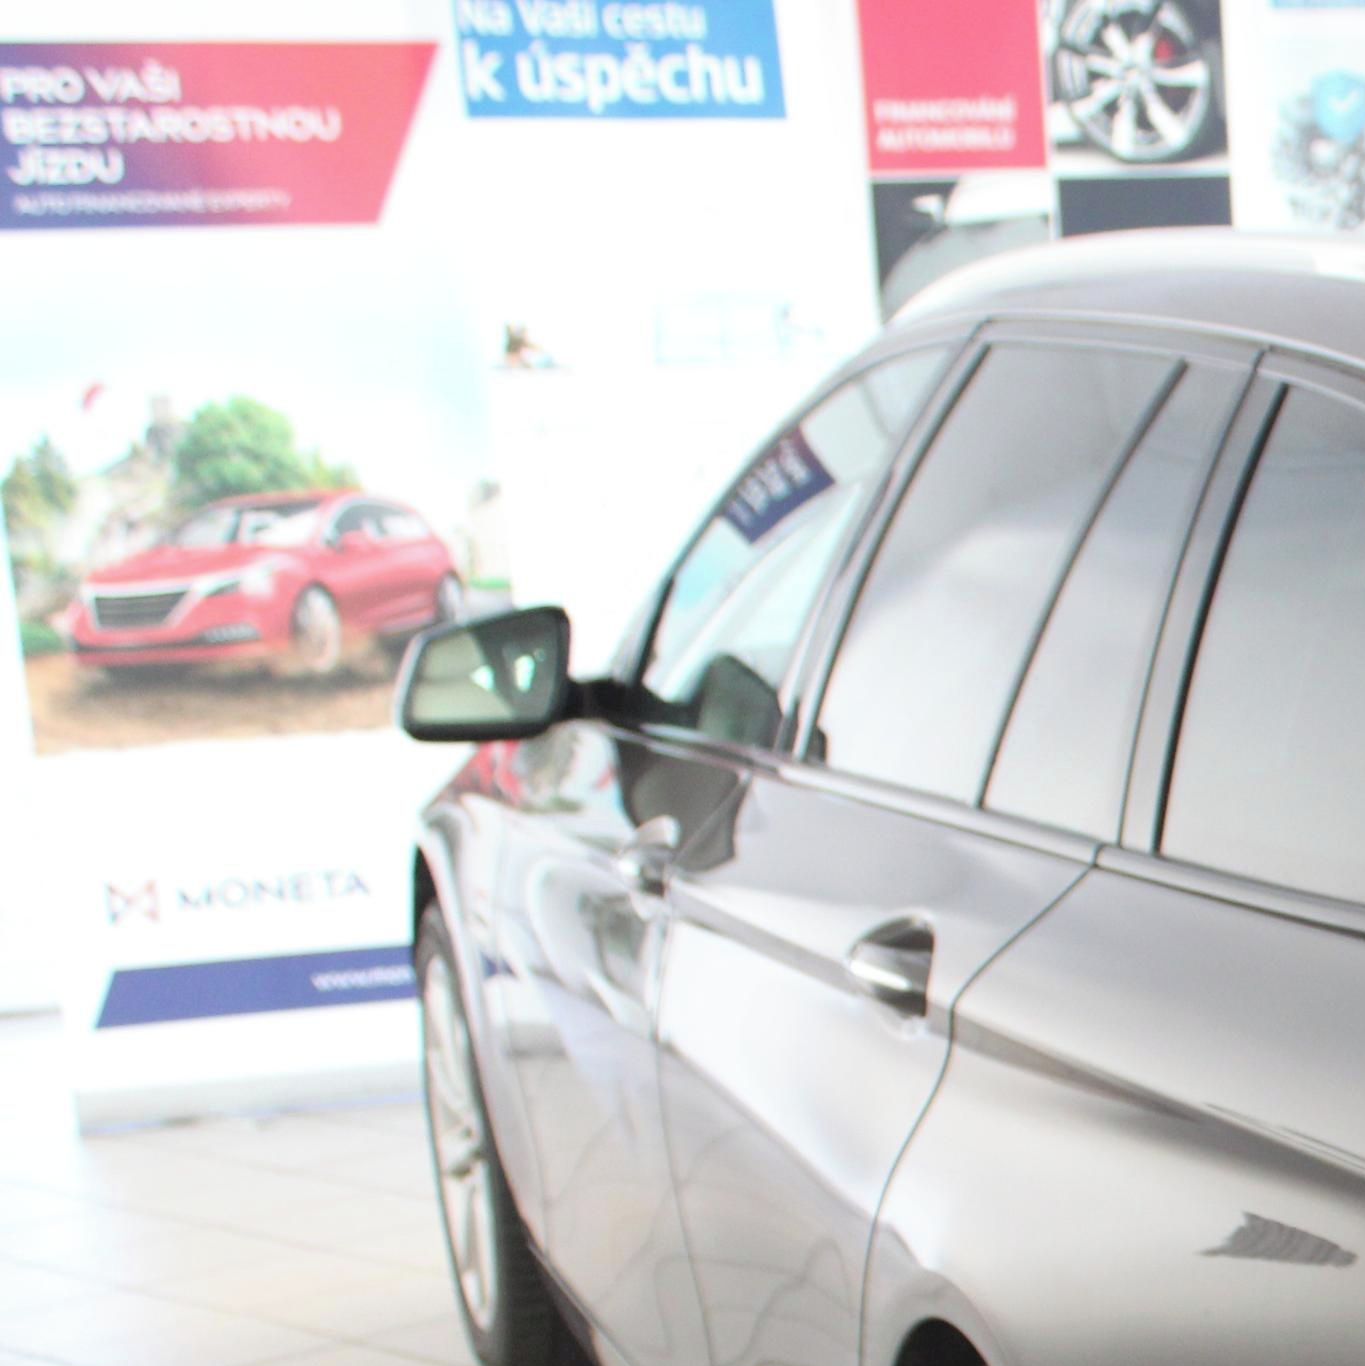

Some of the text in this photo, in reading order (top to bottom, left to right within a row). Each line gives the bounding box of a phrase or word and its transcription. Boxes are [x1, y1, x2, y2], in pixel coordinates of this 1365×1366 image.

[0, 58, 182, 104] PRO VAŠI
[463, 38, 765, 114] k úspěchu
[3, 105, 343, 144] BEZSTAROSTNOU
[8, 143, 125, 185] JÍZDU
[177, 868, 370, 911] MONETA
